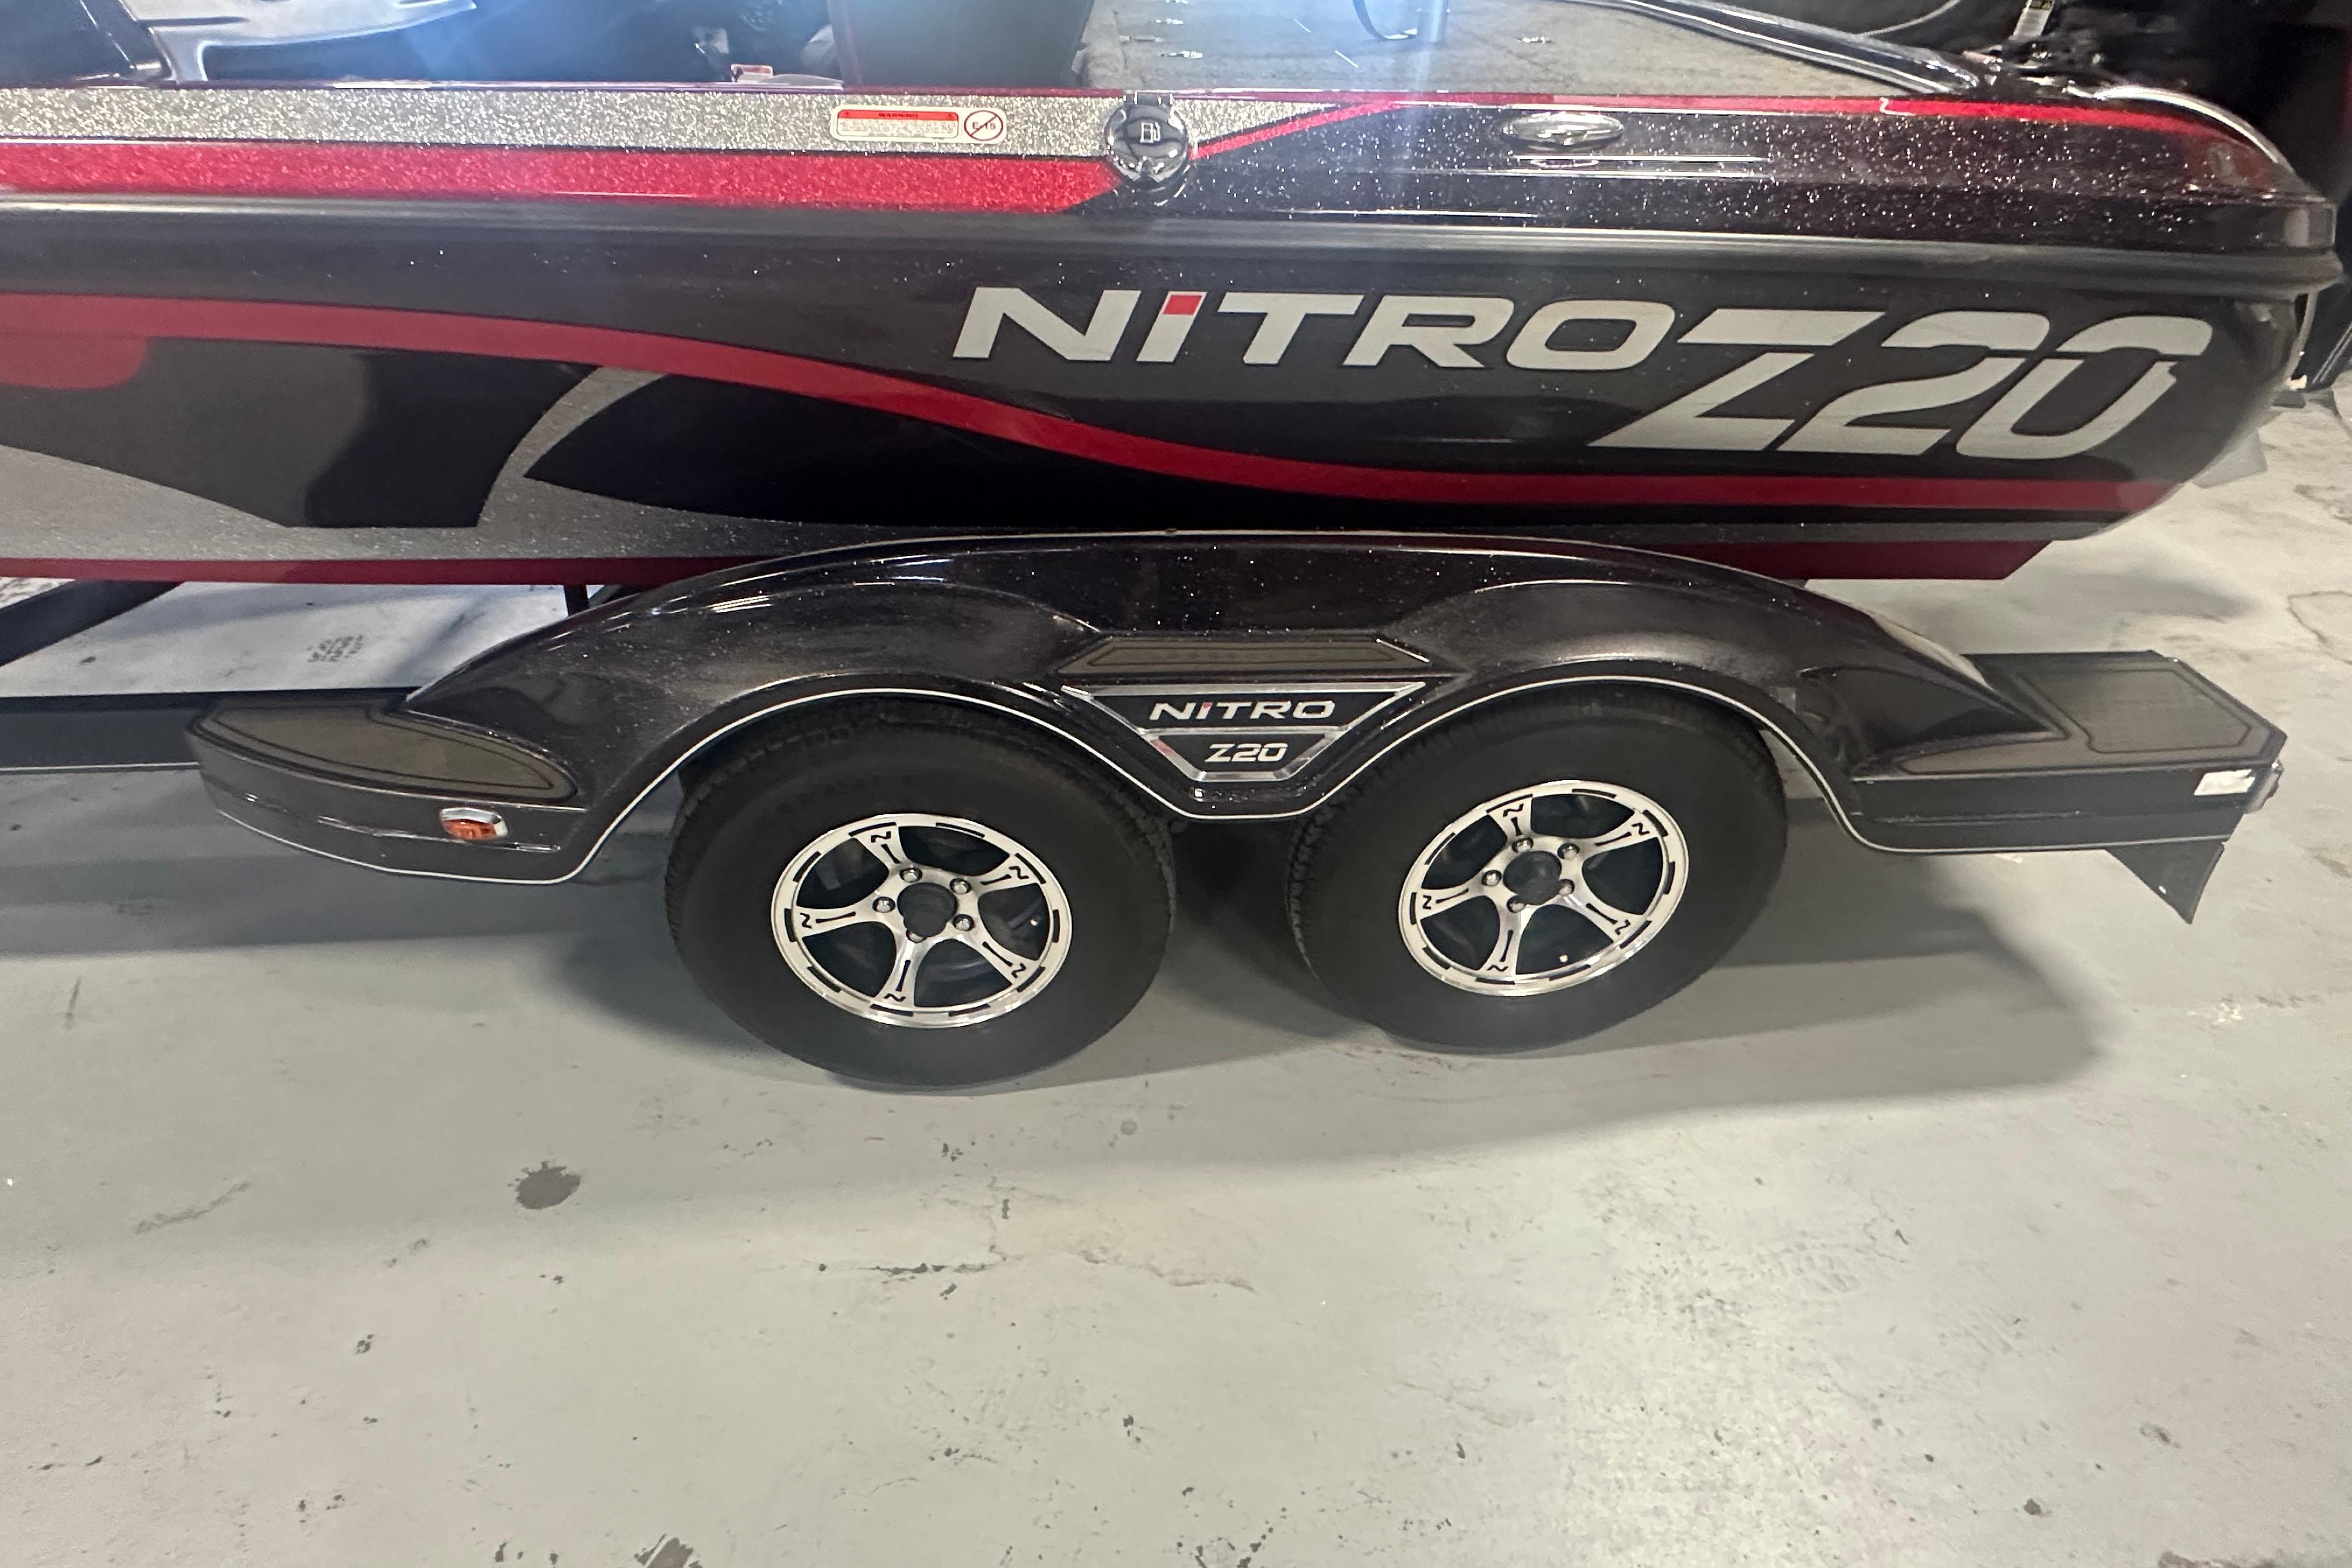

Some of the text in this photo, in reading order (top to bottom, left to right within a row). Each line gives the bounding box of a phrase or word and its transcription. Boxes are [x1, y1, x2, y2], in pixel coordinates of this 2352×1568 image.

[953, 287, 2213, 459] NITRO Z20
[1149, 700, 1336, 720] NITRO
[1204, 743, 1288, 762] Z20
